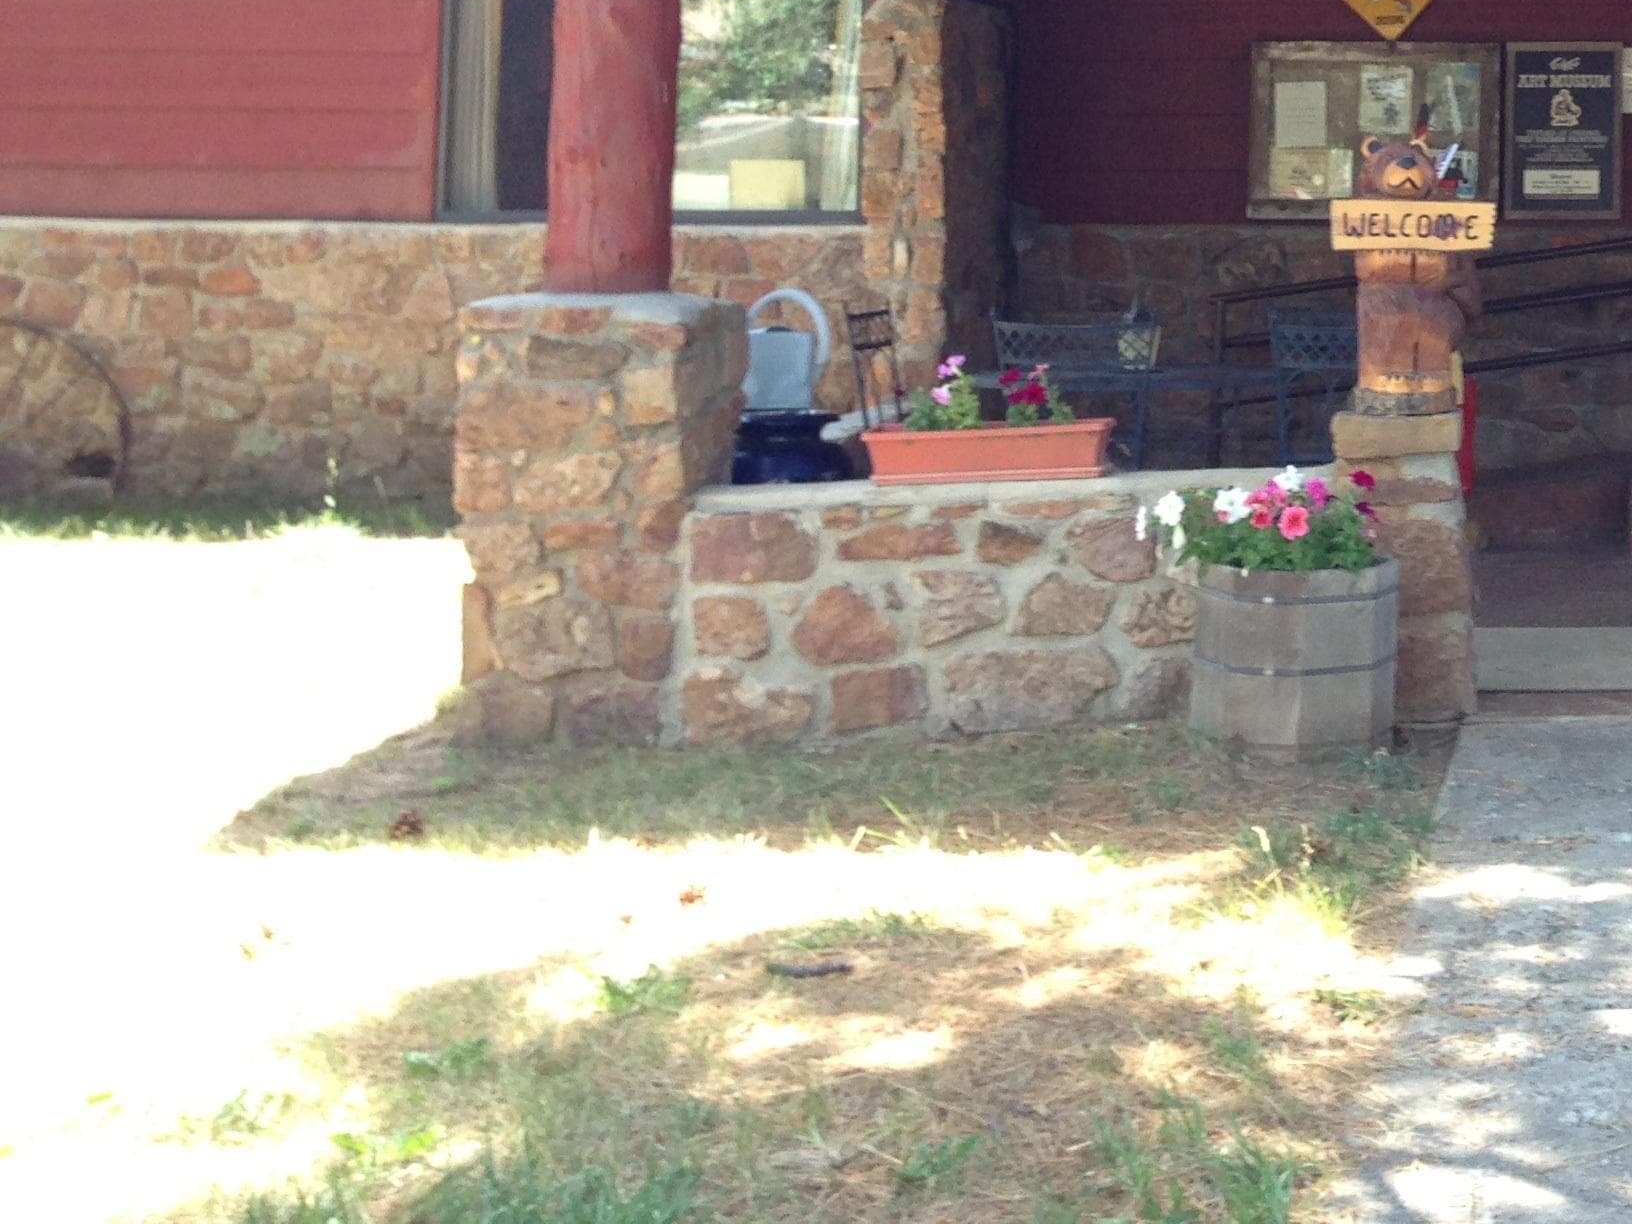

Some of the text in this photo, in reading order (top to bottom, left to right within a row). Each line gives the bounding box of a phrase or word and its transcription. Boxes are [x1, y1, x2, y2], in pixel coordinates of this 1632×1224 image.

[1517, 74, 1548, 88] ART
[1549, 74, 1612, 88] MUSEUM
[1342, 212, 1479, 241] WELCOME
